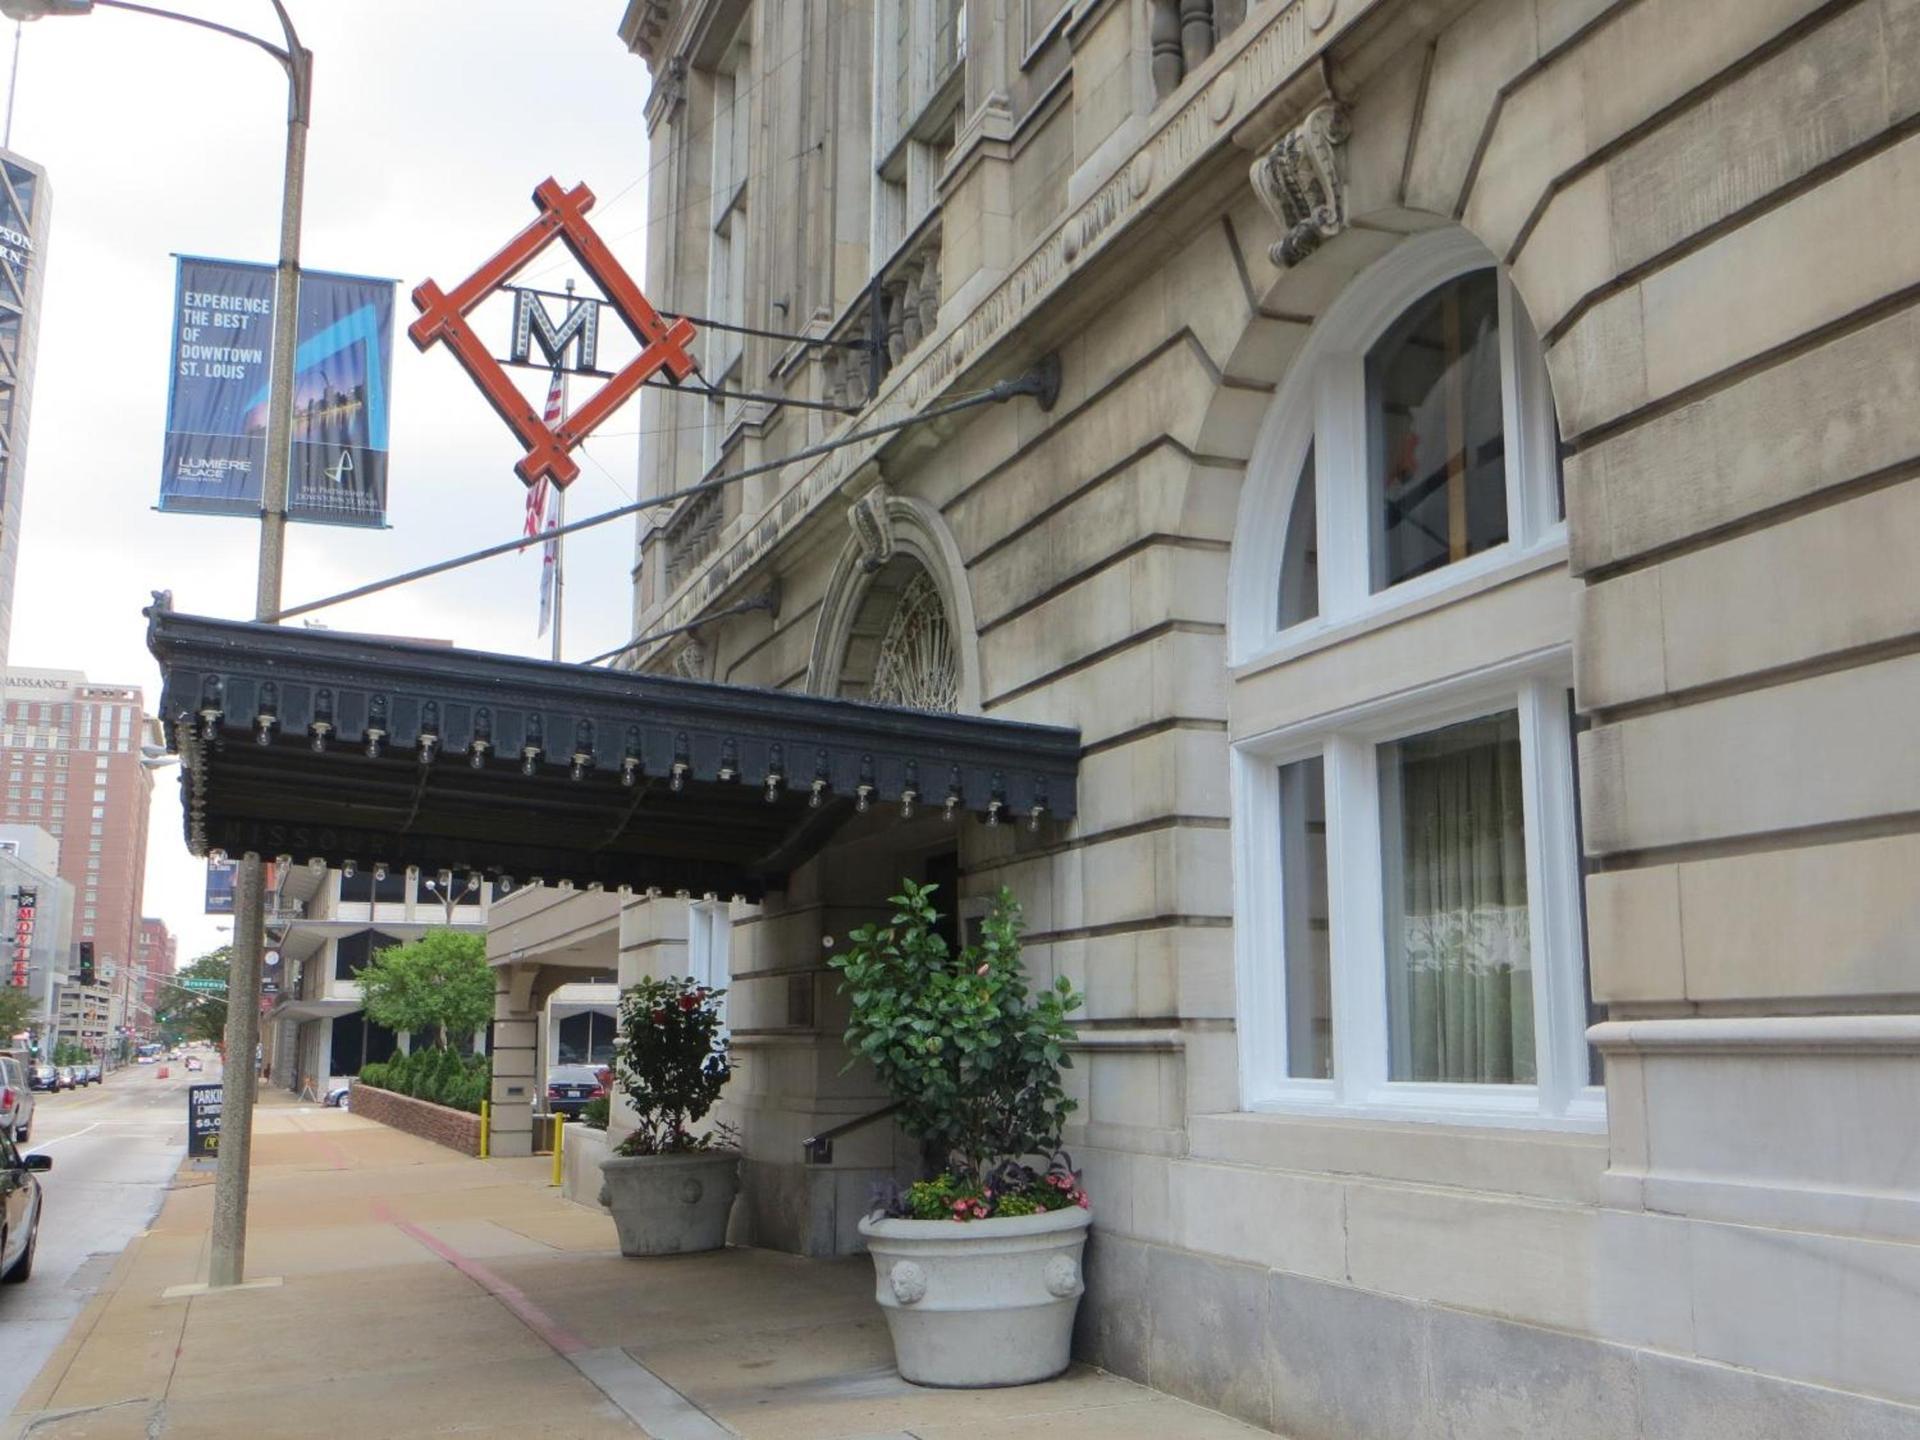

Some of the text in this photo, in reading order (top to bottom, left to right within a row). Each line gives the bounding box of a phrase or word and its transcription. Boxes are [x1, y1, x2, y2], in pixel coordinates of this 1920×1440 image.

[184, 291, 271, 315] EXPERIENCE
[183, 309, 250, 329] THE BEST
[511, 289, 599, 369] M
[182, 327, 201, 342] OF
[181, 344, 263, 364] DOWNTOWN
[180, 362, 245, 380] ST. LOUIS
[178, 467, 224, 478] PLACE
[12, 906, 35, 987] MOVIES
